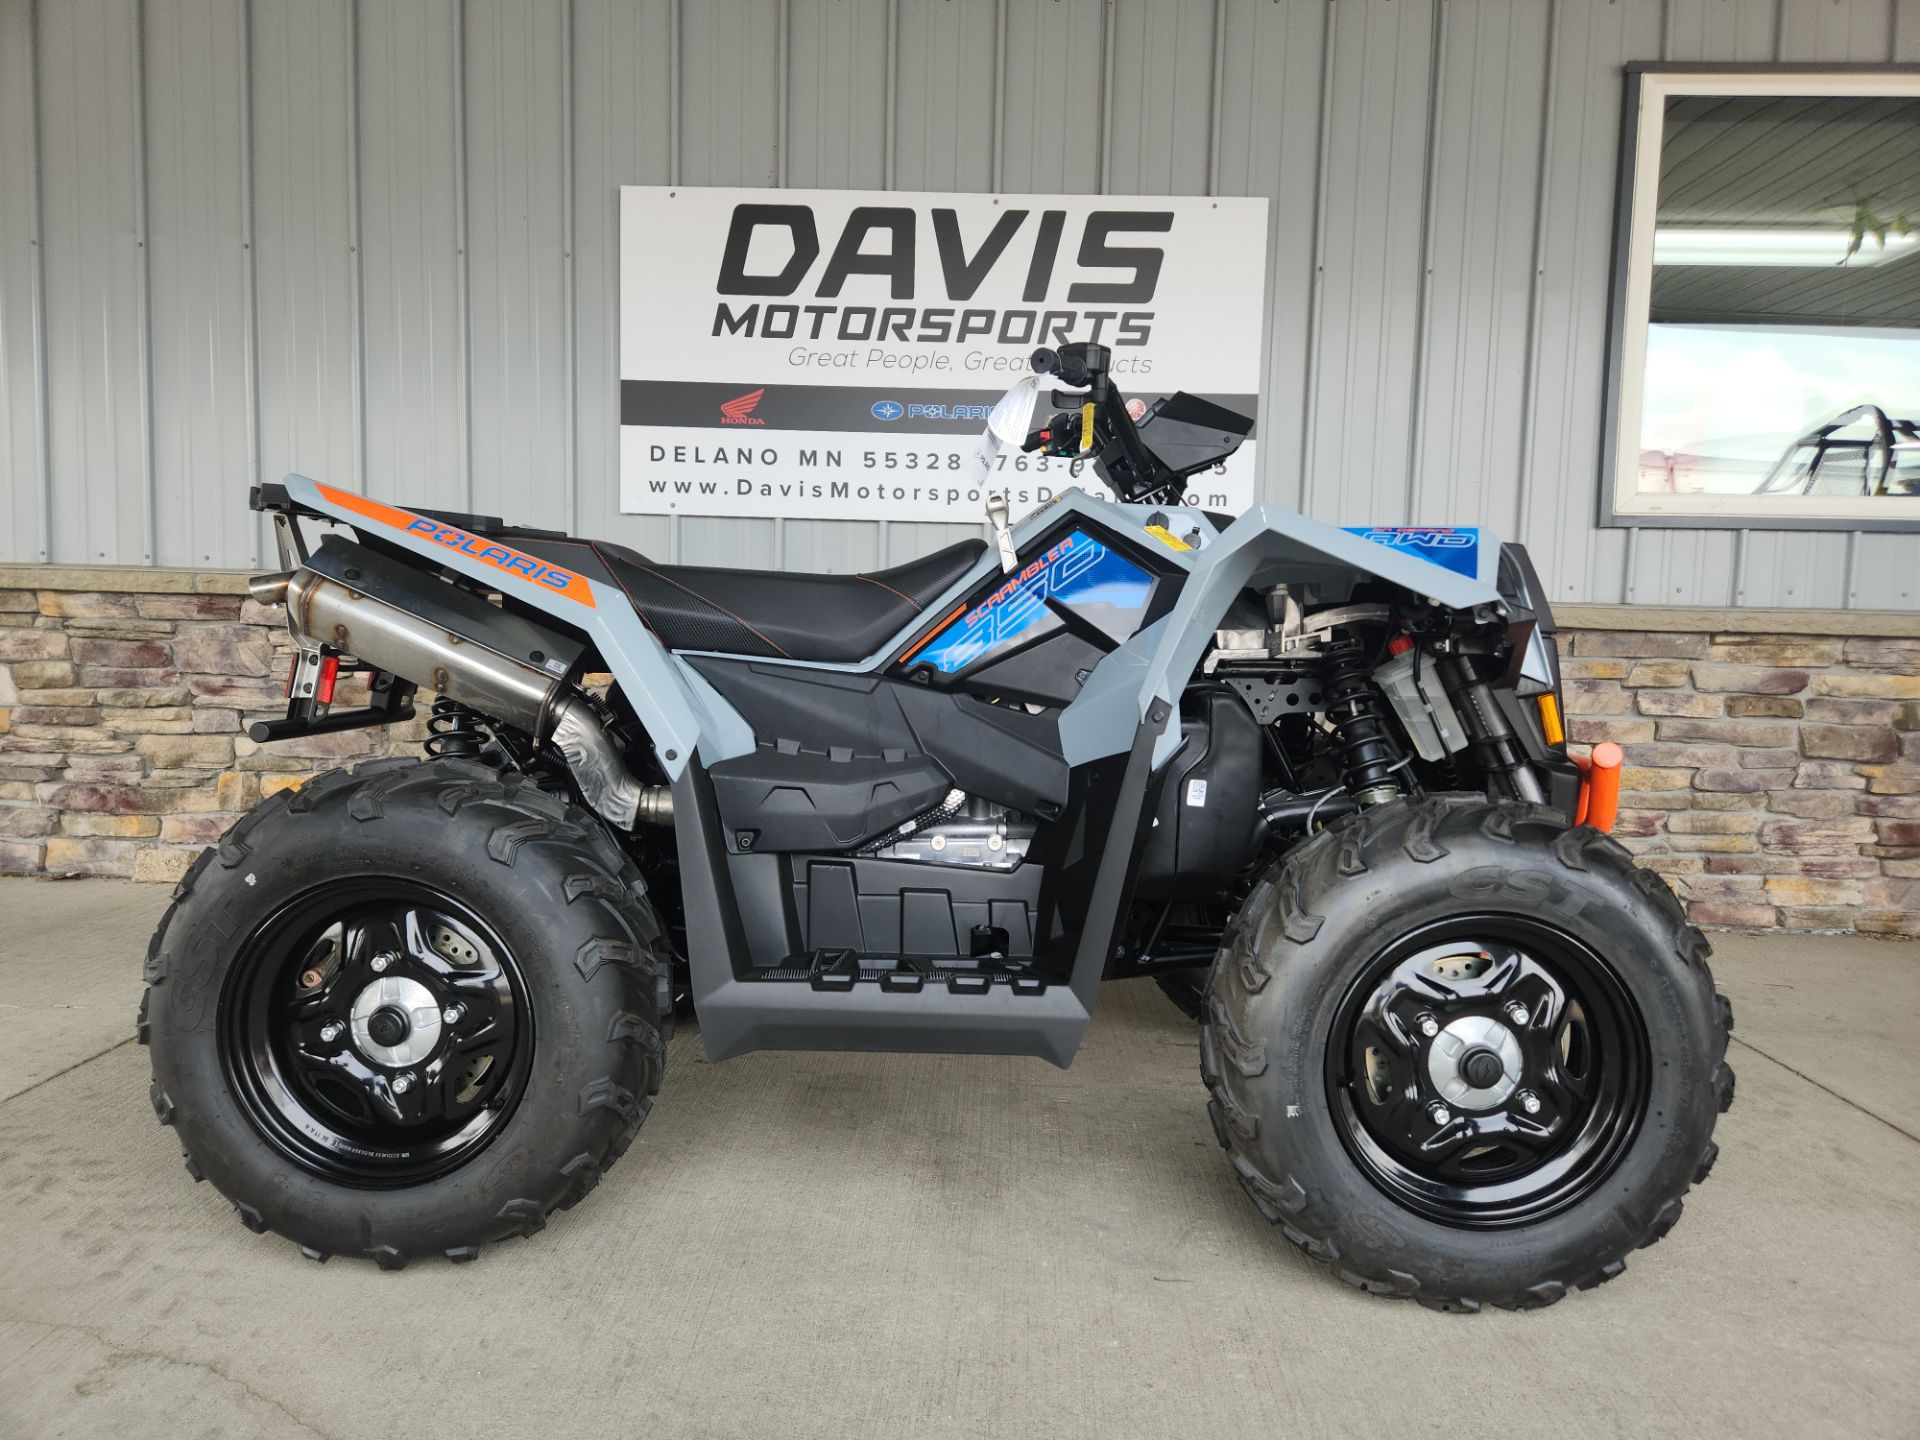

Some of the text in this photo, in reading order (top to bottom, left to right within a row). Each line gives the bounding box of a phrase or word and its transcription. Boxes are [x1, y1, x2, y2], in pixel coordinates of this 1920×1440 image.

[716, 203, 1175, 304] DAVIS
[711, 302, 1155, 346] MOTORSPORTS
[788, 346, 1032, 374] Great People, Great
[720, 417, 765, 425] HONDA
[908, 403, 998, 420] POLARI
[650, 444, 778, 466] DELANO
[799, 449, 842, 467] MN
[863, 451, 961, 470] 55328
[404, 518, 578, 590] POLARIS
[1362, 531, 1476, 548] AWD
[964, 537, 1075, 629] SCRAMBLER
[943, 538, 1106, 673] 850
[1449, 865, 1608, 917] CST
